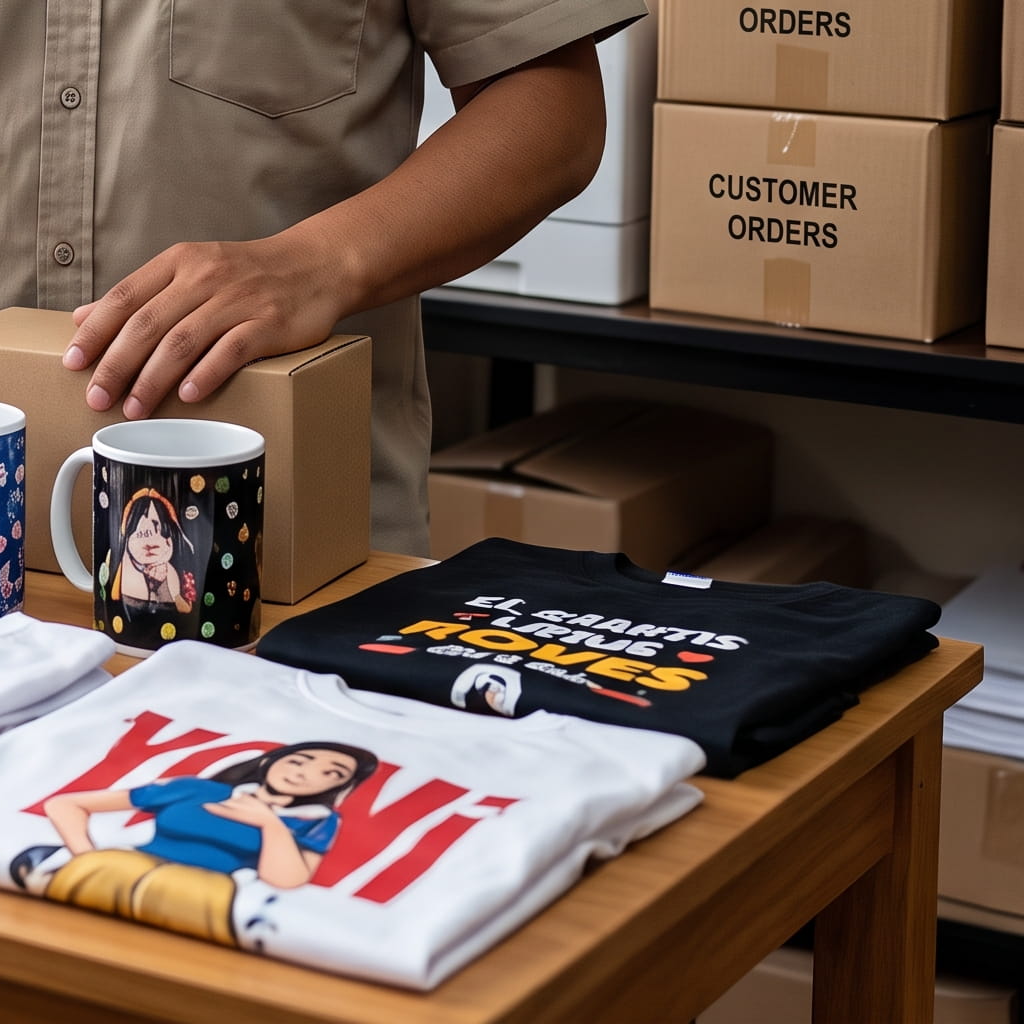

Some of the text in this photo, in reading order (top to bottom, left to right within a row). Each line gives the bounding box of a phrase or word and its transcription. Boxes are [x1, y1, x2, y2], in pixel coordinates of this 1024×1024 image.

[739, 7, 852, 38] ORDERS
[709, 173, 858, 211] CUSTOMER
[728, 214, 838, 249] ORDERS
